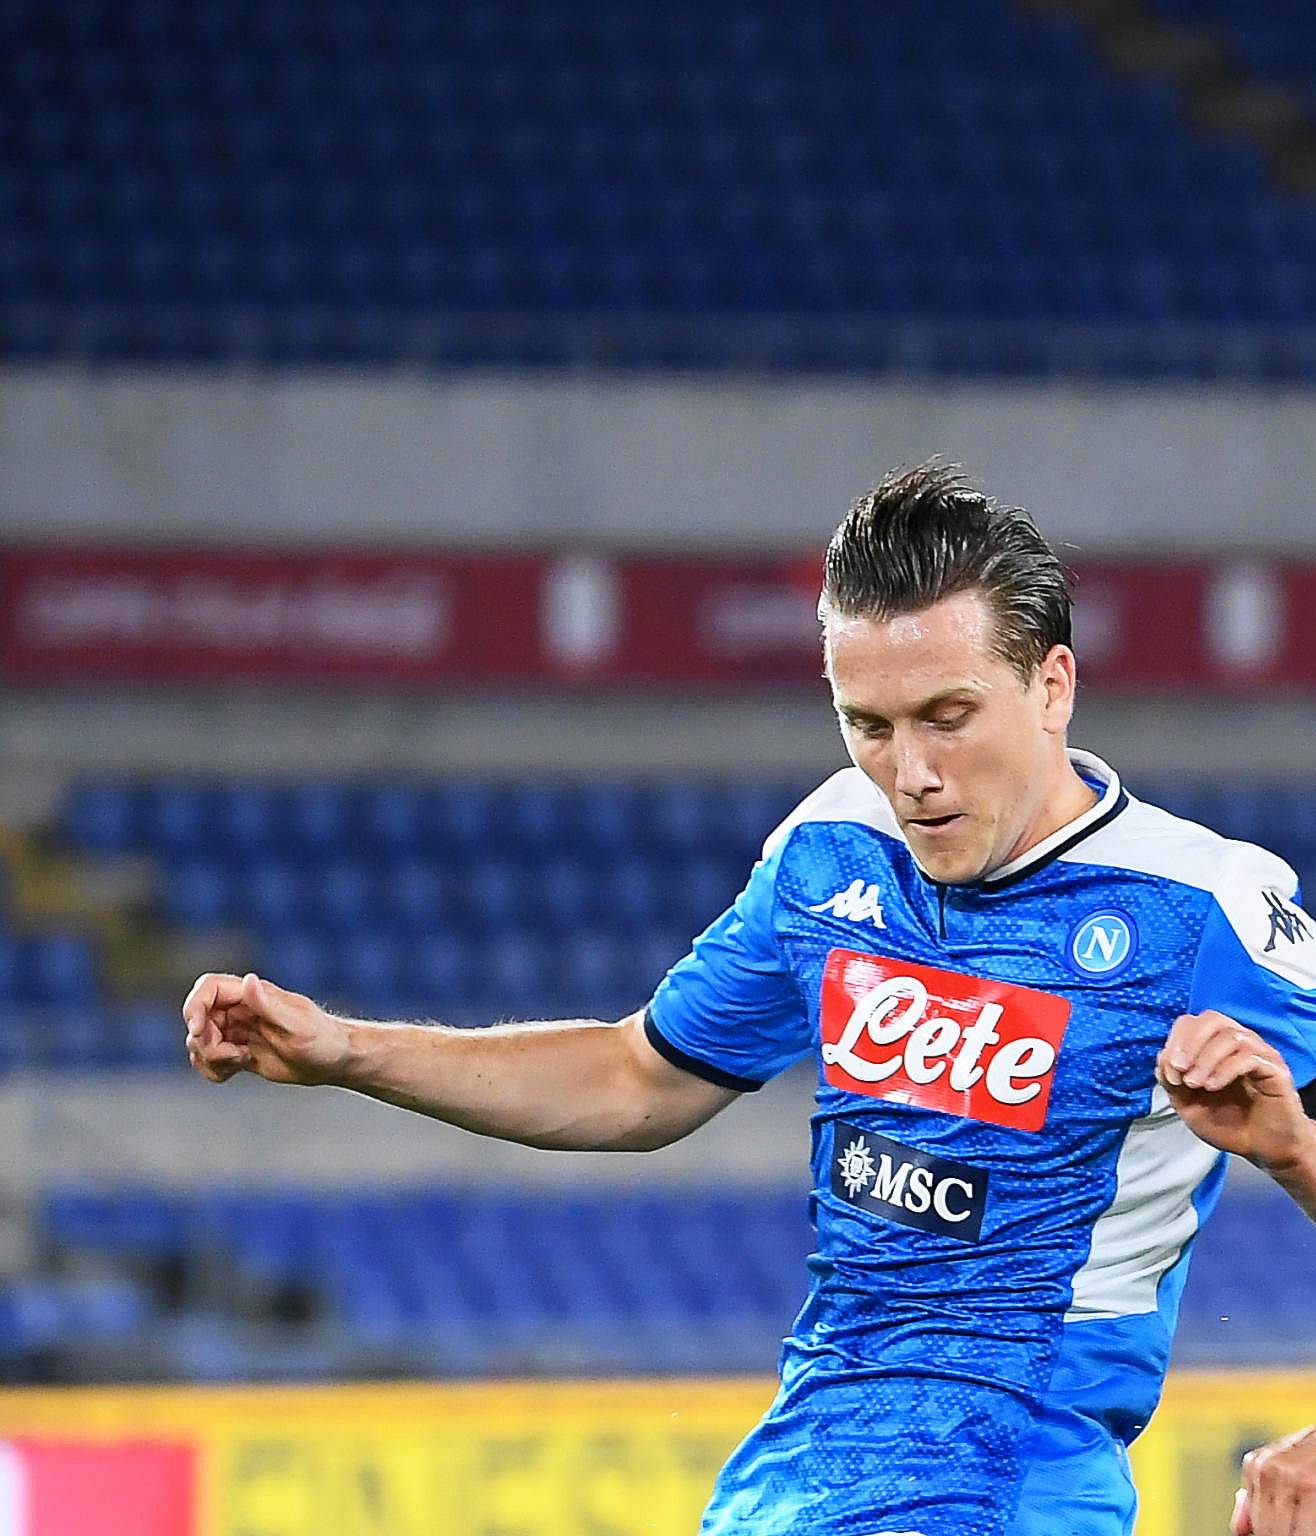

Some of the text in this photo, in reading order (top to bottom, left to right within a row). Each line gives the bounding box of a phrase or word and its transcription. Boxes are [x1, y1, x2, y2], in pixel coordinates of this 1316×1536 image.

[1081, 925, 1124, 962] N
[821, 975, 1056, 1105] Lete
[869, 1152, 974, 1223] MSC
